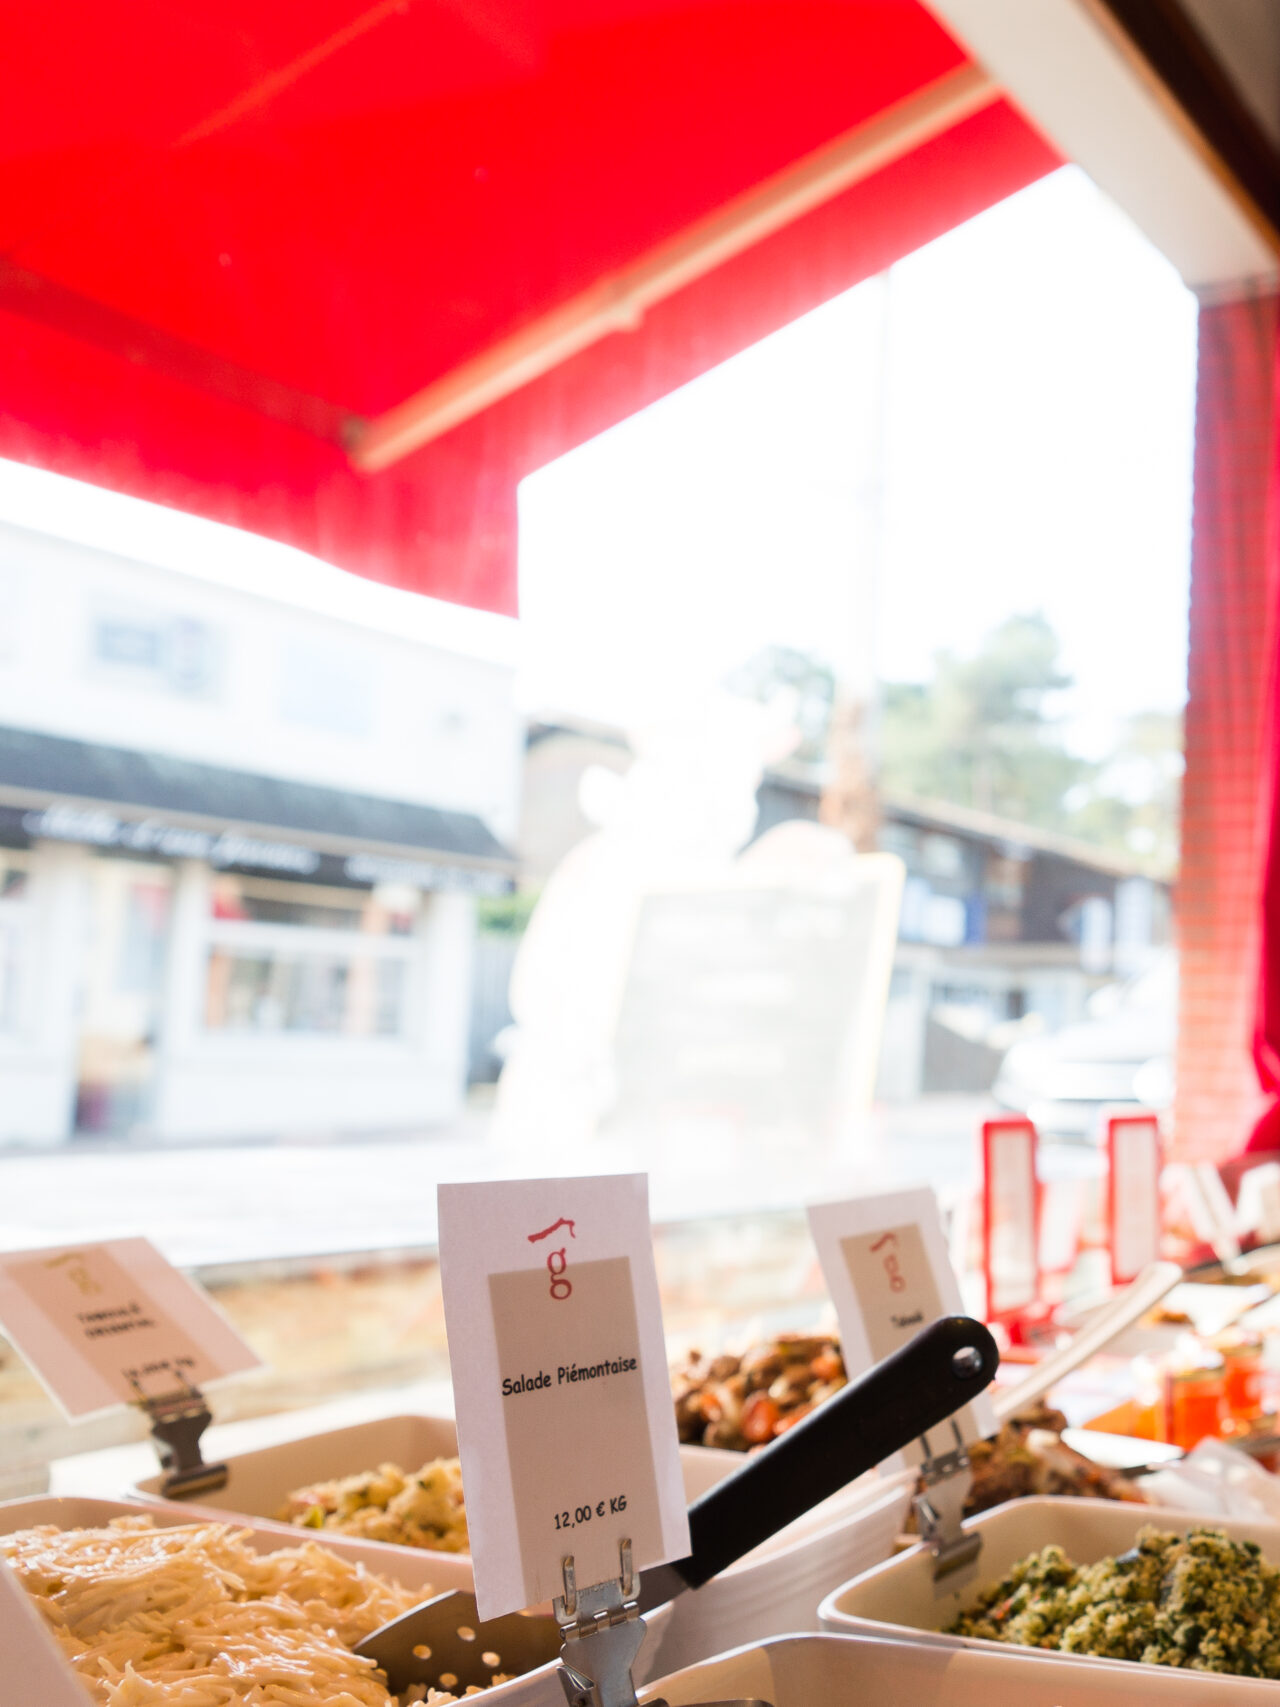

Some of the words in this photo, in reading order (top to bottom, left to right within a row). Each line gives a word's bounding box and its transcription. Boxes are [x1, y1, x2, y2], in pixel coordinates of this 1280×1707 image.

[502, 1371, 552, 1396] Salade
[557, 1356, 637, 1385] Piémontaise
[554, 1505, 592, 1530] 12,00
[596, 1501, 605, 1517] €
[610, 1495, 627, 1513] KG
